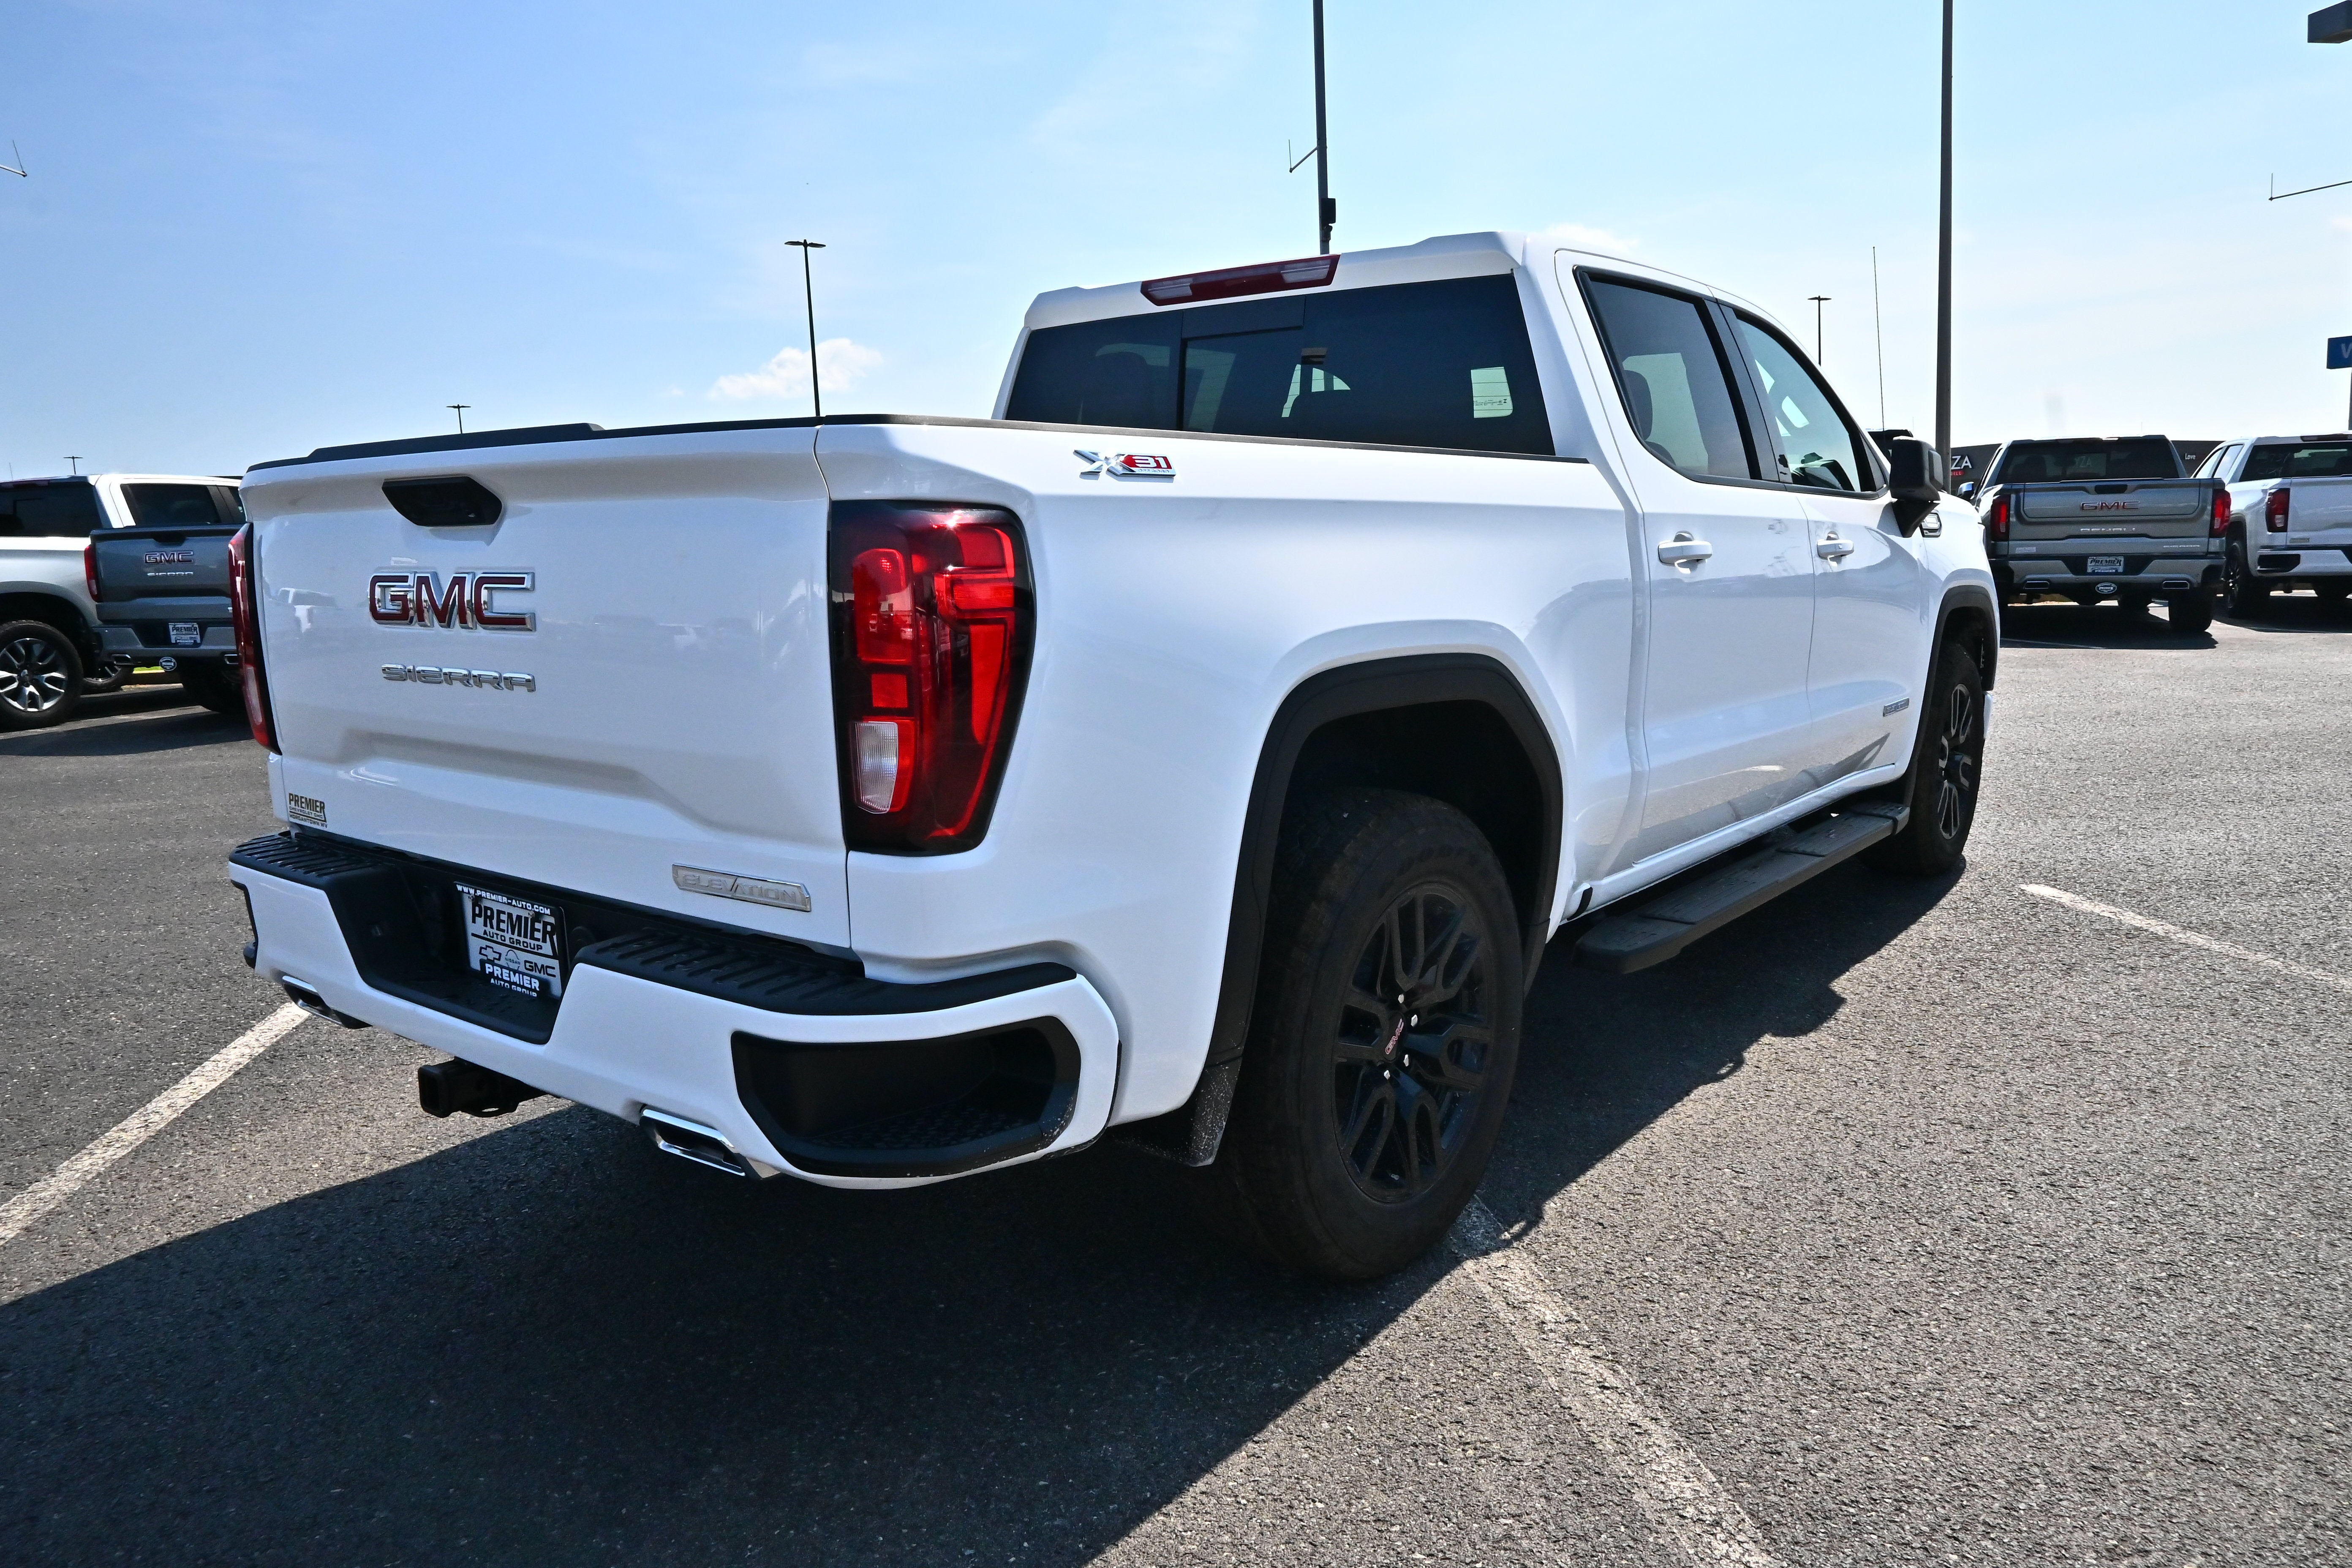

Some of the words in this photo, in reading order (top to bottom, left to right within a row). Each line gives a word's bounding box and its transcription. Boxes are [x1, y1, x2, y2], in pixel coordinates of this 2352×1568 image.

[1951, 455, 1972, 470] ZA
[2080, 501, 2140, 511] GMC
[144, 551, 193, 564] GMC
[369, 571, 536, 632] GMC
[381, 664, 536, 693] SIERRA
[289, 793, 325, 814] PREMIER
[456, 884, 550, 915] WWW.PREMIER-AUTO.COM
[683, 874, 797, 903] ELEVATION
[471, 902, 557, 944] PREMIER
[483, 929, 506, 942] AUTO
[509, 936, 542, 951] GROUP
[485, 963, 540, 991] PREMIER
[524, 960, 556, 977] GMC
[490, 978, 509, 988] AUTO
[1385, 1018, 1404, 1055] GMC
